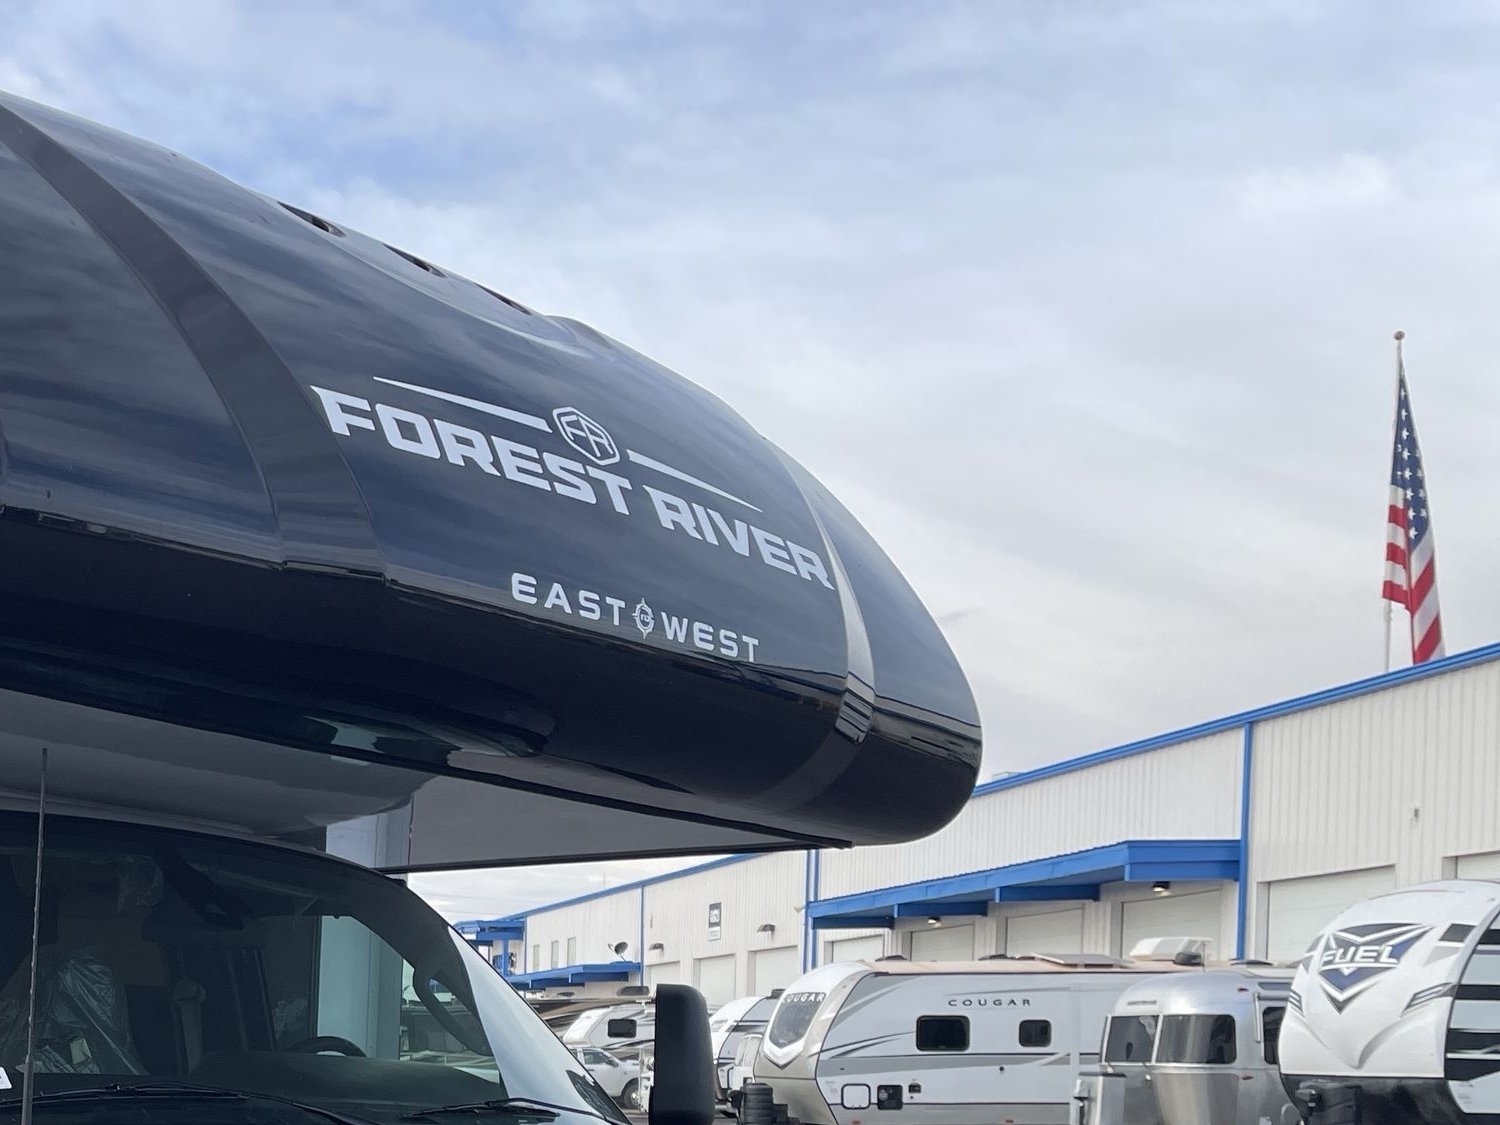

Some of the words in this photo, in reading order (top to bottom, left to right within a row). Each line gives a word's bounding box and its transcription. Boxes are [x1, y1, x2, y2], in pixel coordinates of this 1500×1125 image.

[310, 385, 633, 516] FOREST
[643, 484, 836, 591] RIVER
[511, 572, 626, 627] EAST
[660, 611, 760, 664] WEST
[1320, 944, 1399, 965] FUEL
[948, 998, 1031, 1007] COUGAR
